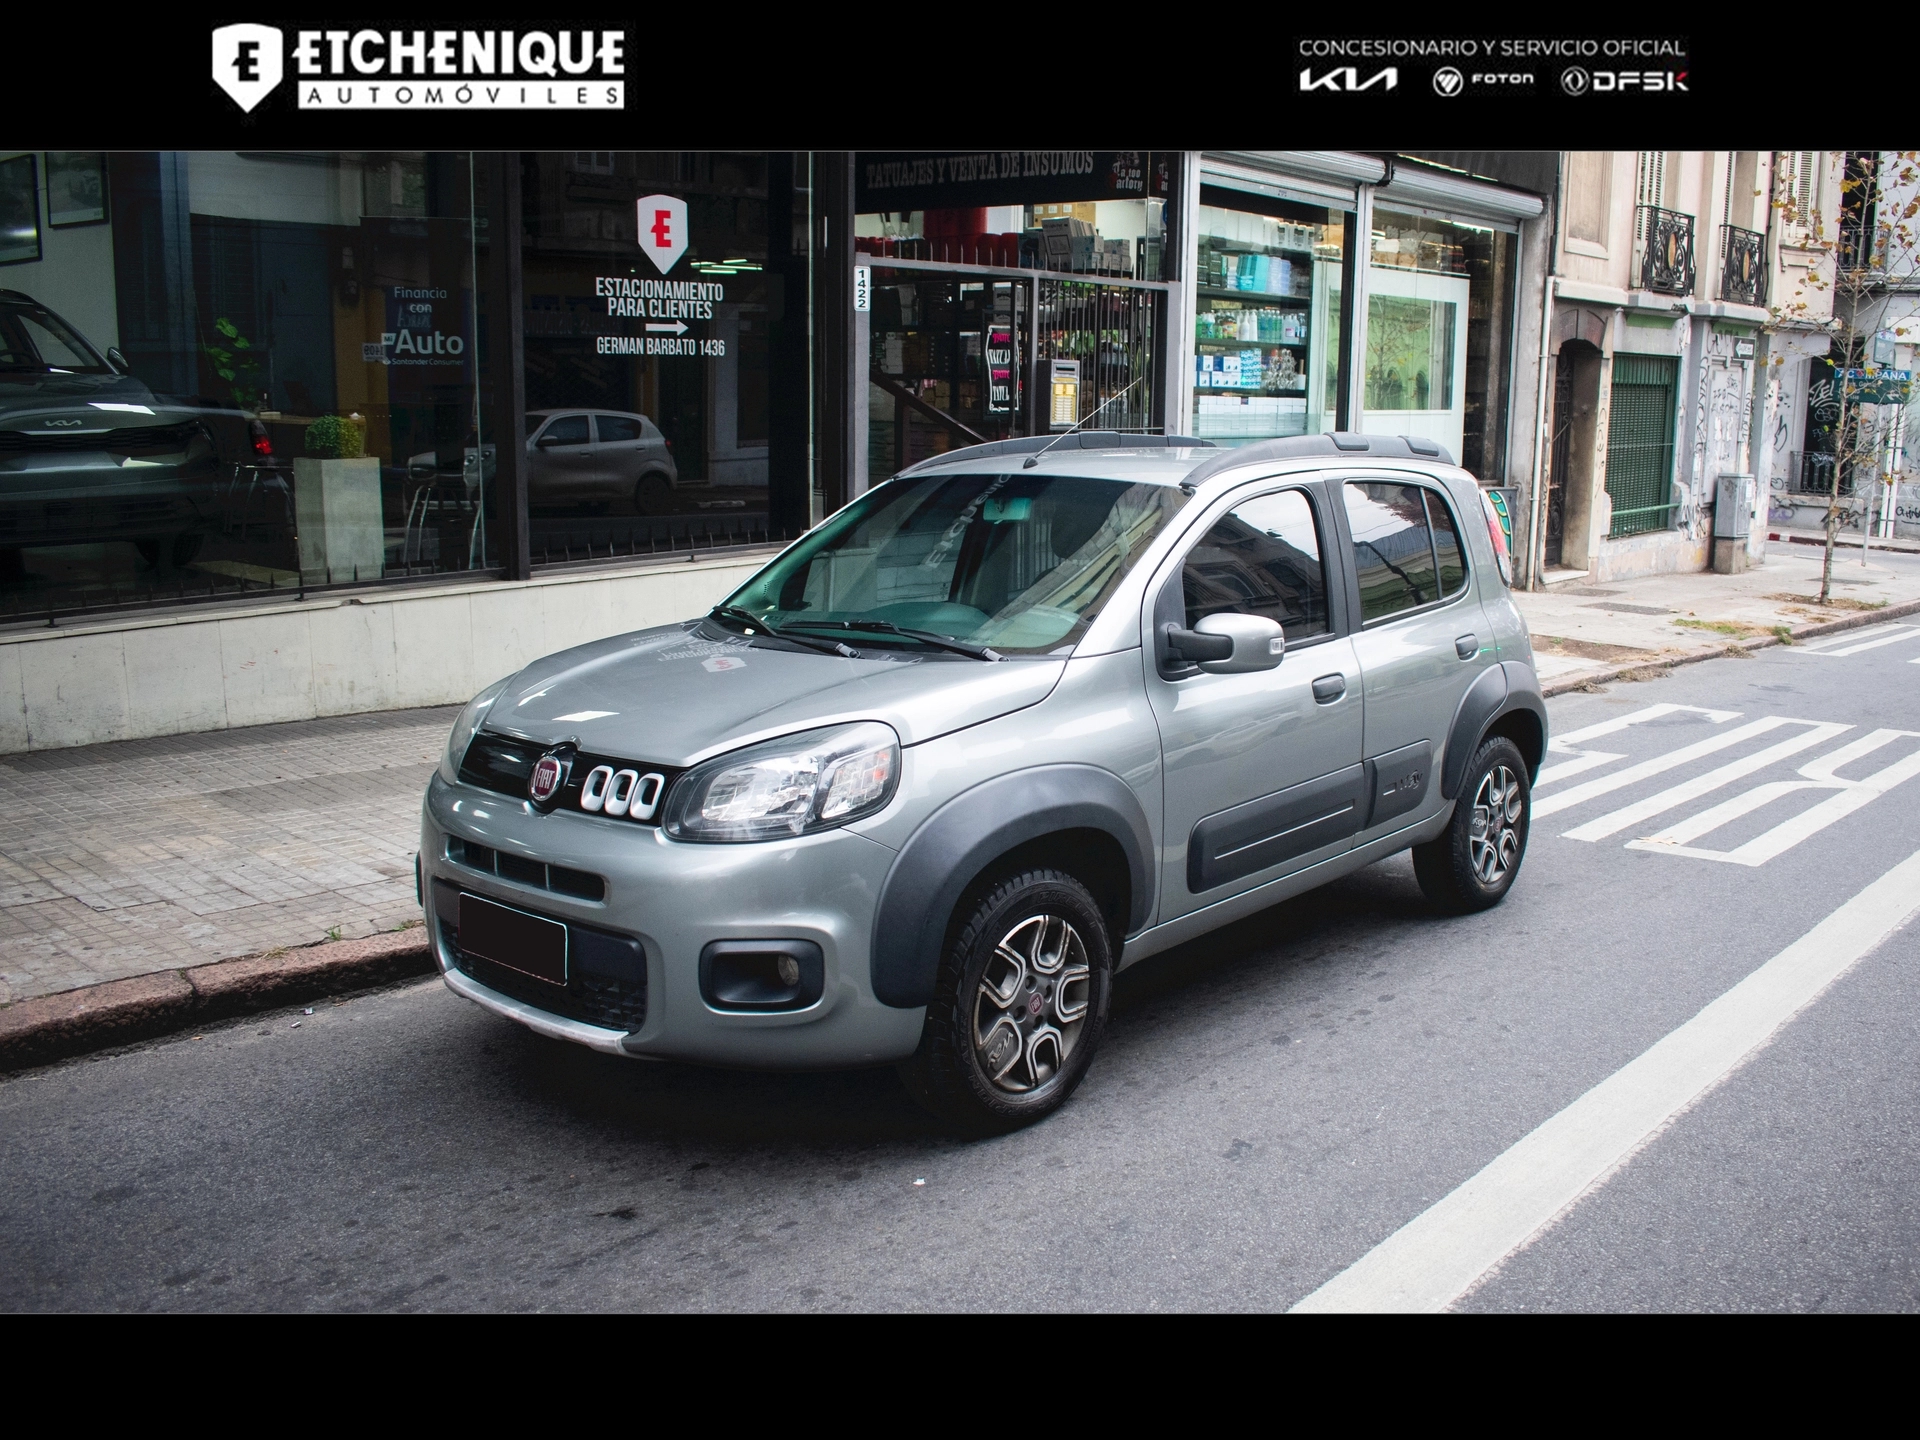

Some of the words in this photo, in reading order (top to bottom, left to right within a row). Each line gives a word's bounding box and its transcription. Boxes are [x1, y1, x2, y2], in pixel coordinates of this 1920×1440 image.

[866, 158, 934, 189] TATUAJES
[936, 157, 947, 183] Y
[948, 153, 998, 182] VENTA
[1000, 152, 1020, 178] DE
[1022, 151, 1094, 177] INSUMOS
[394, 286, 447, 299] Financia
[595, 277, 724, 301] ESTACIONAMIENTO
[857, 269, 867, 308] 1422
[409, 303, 432, 314] con
[607, 297, 646, 317] PARA
[649, 299, 713, 319] CLIENTES
[395, 328, 464, 355] Auto
[596, 336, 644, 355] GERMAN
[646, 338, 696, 356] BARBATO
[699, 339, 725, 356] 1436
[391, 357, 428, 365] Santander
[536, 768, 554, 789] FIAT
